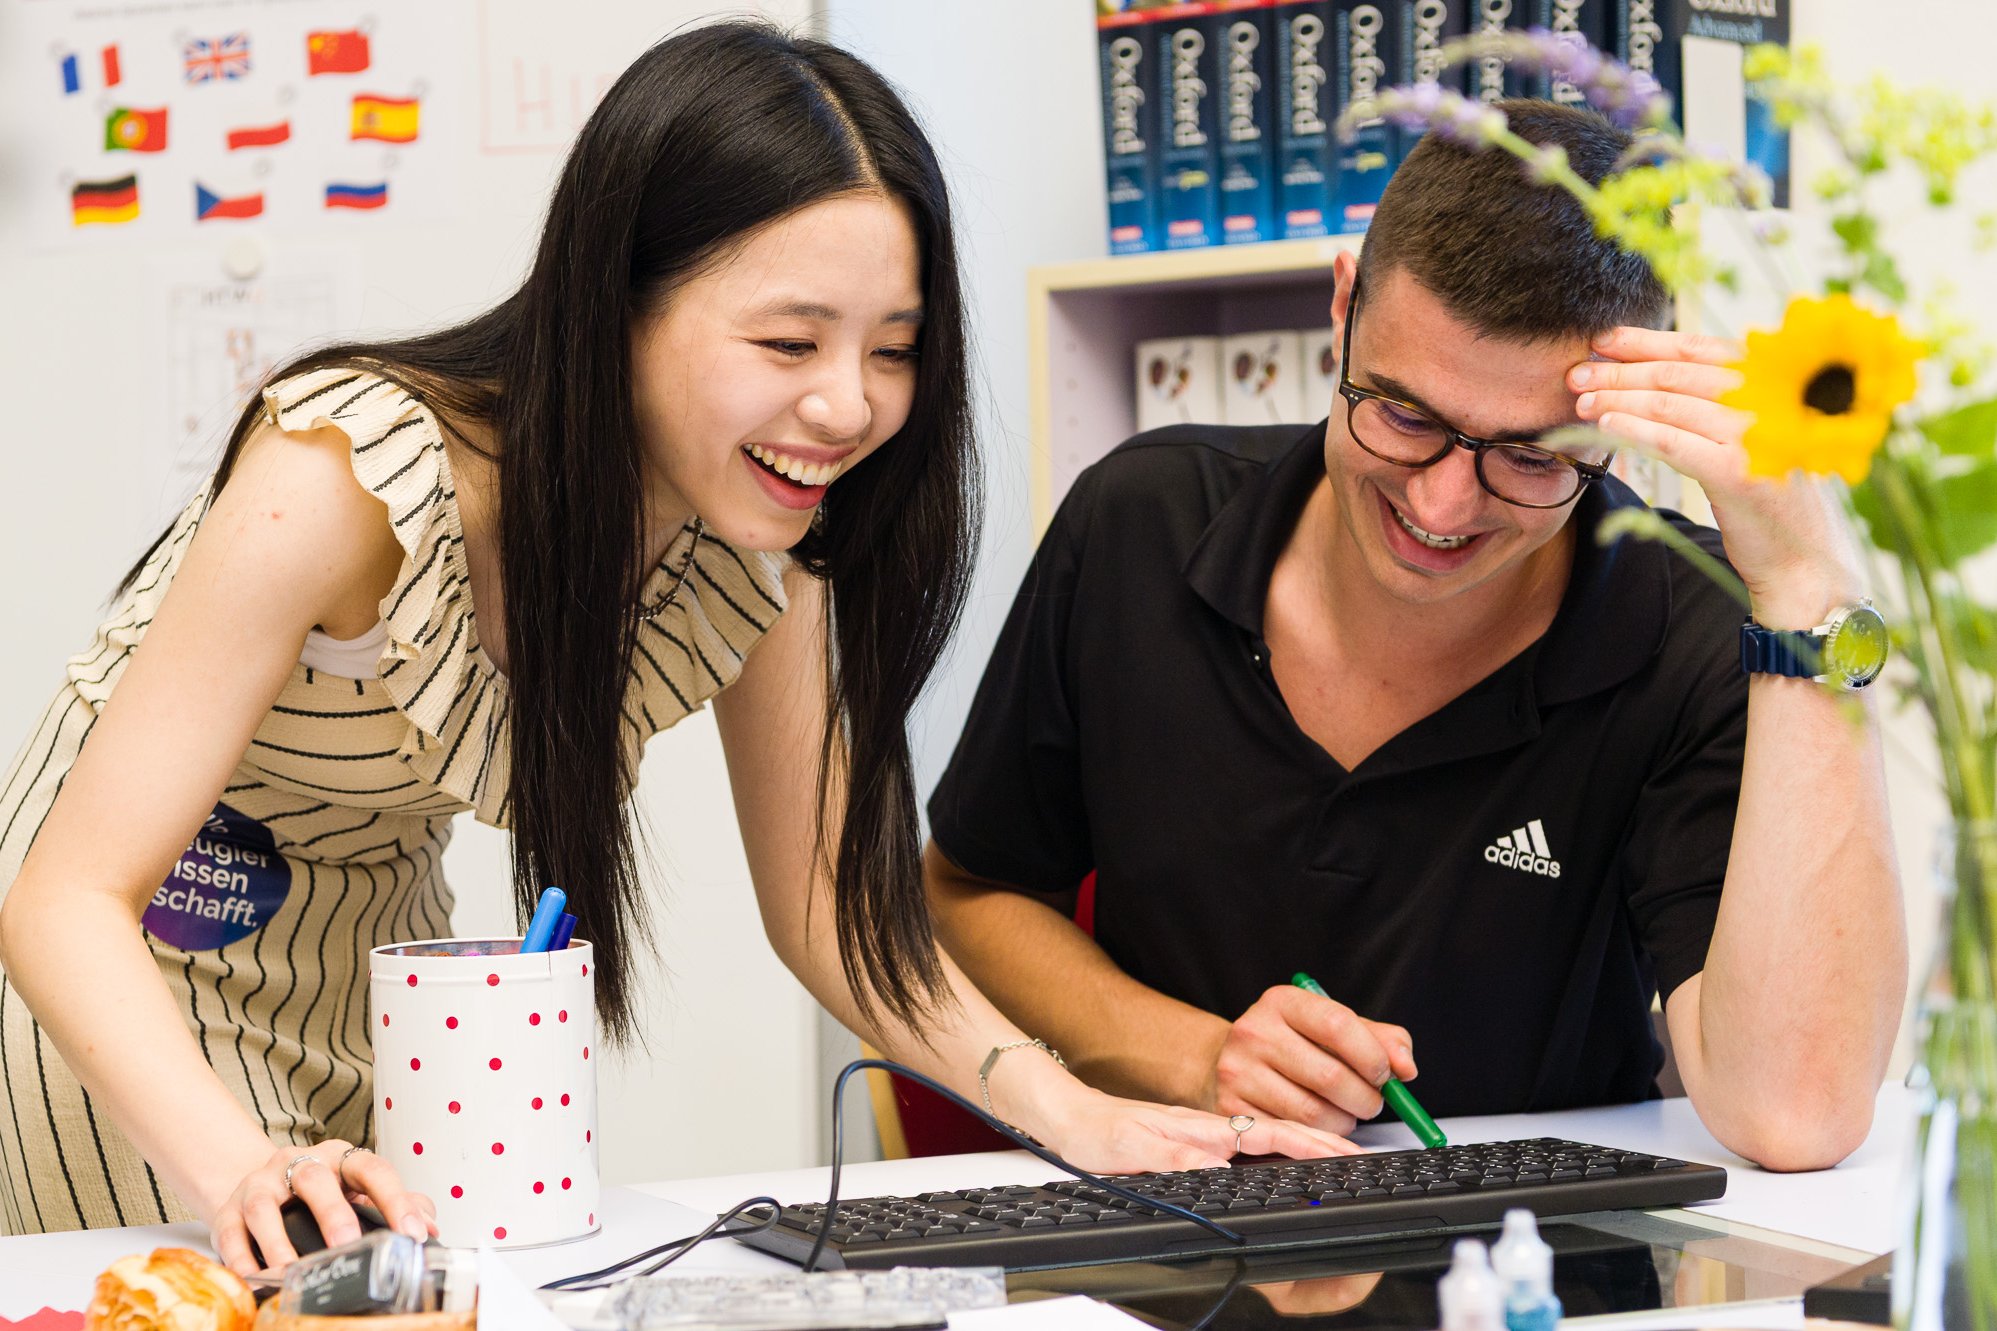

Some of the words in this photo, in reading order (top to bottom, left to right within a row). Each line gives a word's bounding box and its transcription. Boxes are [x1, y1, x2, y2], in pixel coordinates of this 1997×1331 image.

[1109, 36, 1146, 155] Oxford
[1171, 27, 1208, 147] Oxford
[1228, 20, 1262, 142] Oxford
[1290, 13, 1327, 136] Oxford
[1349, 4, 1385, 128] Oxfor
[1480, 0, 1512, 103] Oxor
[1628, 0, 1663, 95] xford
[173, 859, 249, 895] issen
[187, 837, 270, 868] ugier
[1484, 845, 1561, 878] adidas
[151, 886, 258, 928] schafft.
